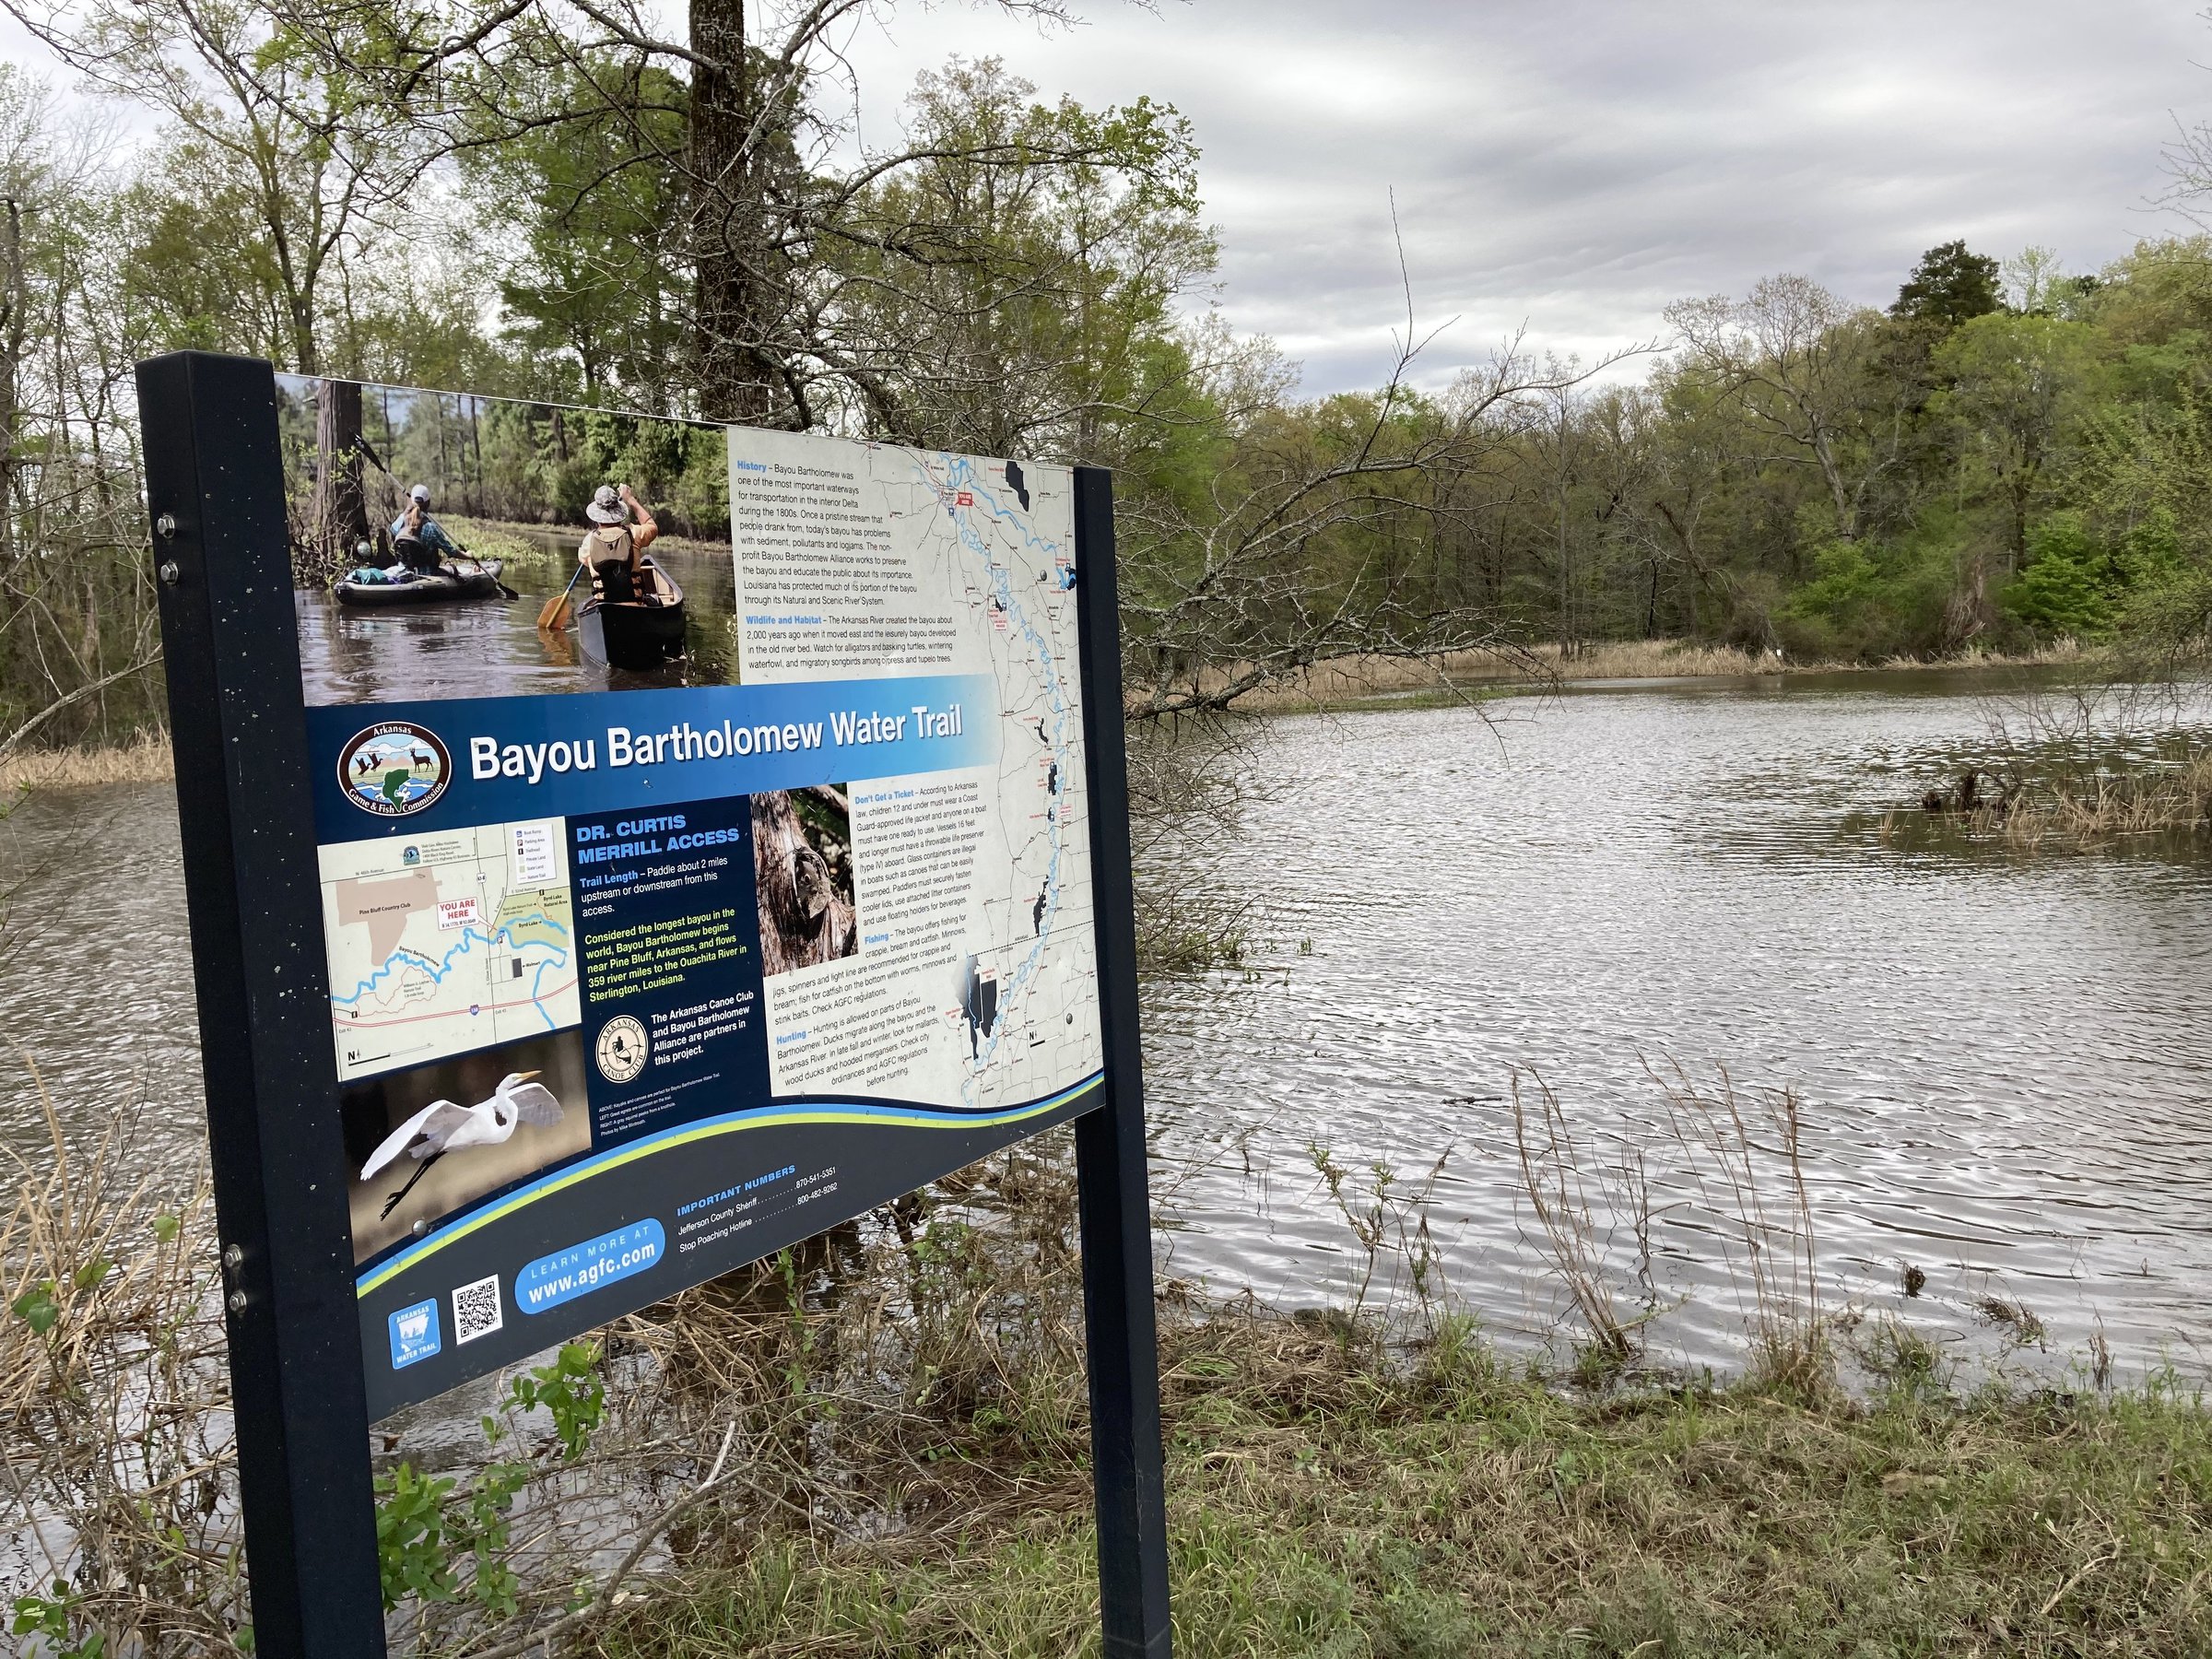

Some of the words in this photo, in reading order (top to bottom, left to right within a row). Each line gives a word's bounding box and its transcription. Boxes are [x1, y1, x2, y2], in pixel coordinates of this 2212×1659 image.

[737, 460, 766, 473] History
[774, 463, 796, 475] Bayou
[797, 466, 840, 478] Bartholomew
[738, 477, 751, 485] one
[752, 477, 760, 486] of
[761, 478, 773, 487] the
[793, 482, 824, 491] important
[826, 485, 859, 495] waterways
[738, 490, 748, 500] for
[749, 492, 798, 503] transportation
[807, 496, 818, 505] the
[819, 498, 841, 506] interior
[842, 498, 858, 508] Delta
[746, 615, 776, 624] Wildlife
[778, 615, 792, 624] and
[794, 615, 821, 624] Habitat
[828, 615, 840, 624] The
[841, 616, 868, 624] Arkansas
[869, 615, 884, 624] River
[918, 616, 936, 625] bayou
[373, 725, 412, 736] Arkansas
[470, 737, 596, 783] Bayou
[607, 722, 824, 766] Bartholomew
[829, 711, 907, 746] Water
[911, 704, 962, 738] Trail
[348, 788, 370, 808] Game
[370, 802, 377, 811] &
[379, 804, 394, 813] Fish
[402, 782, 444, 813] Commission
[855, 795, 873, 804] Don't
[874, 793, 887, 801] Get
[893, 789, 914, 799] Ticket
[919, 786, 947, 795] According
[954, 782, 978, 790] Arkansas
[577, 825, 611, 842] DR.
[616, 815, 686, 836] CURTIS
[578, 840, 662, 863] MERRILL
[666, 828, 739, 850] ACCESS
[579, 875, 602, 887] Trail
[604, 870, 638, 884] Length
[647, 865, 675, 877] Paddle
[677, 860, 699, 872] about
[701, 859, 706, 868] 2
[708, 857, 728, 867] miles
[581, 889, 621, 903] upstream
[622, 887, 631, 895] or
[633, 878, 683, 893] downstream
[684, 875, 702, 884] from
[703, 871, 718, 881] this
[440, 902, 458, 911] YOU
[459, 899, 475, 908] ARE
[448, 910, 469, 919] HERE
[582, 905, 615, 917] access.
[585, 926, 636, 944] Considered
[638, 924, 652, 934] the
[654, 917, 685, 931] longest
[687, 913, 711, 924] bayou
[713, 910, 720, 919] in
[722, 908, 735, 917] the
[864, 933, 889, 944] Fishing
[894, 928, 905, 937] The
[906, 925, 924, 934] bayou
[924, 920, 940, 930] offers
[941, 916, 958, 925] fishing
[585, 945, 614, 959] world,
[616, 941, 643, 953] Bayou
[645, 929, 701, 947] Bartholomew
[702, 923, 729, 935] begins
[587, 962, 608, 973] near
[609, 958, 629, 968] Pine
[631, 951, 654, 964] Bluff,
[656, 944, 697, 958] Arkansas,
[699, 938, 714, 949] and
[715, 935, 737, 946] flows
[588, 975, 605, 988] 359
[607, 972, 627, 983] river
[628, 967, 652, 979] miles
[653, 964, 662, 973] to
[664, 961, 678, 970] the
[680, 952, 716, 967] Ouachita
[718, 948, 738, 958] River
[739, 945, 747, 954] in
[589, 985, 641, 1002] Sterlington,
[642, 974, 685, 989] Louisiana.
[650, 1013, 667, 1024] The
[669, 1004, 707, 1019] Arkansas
[709, 997, 734, 1009] Canoe
[736, 990, 753, 1002] Club
[776, 1031, 806, 1044] Hunting
[813, 1021, 838, 1034] Hunting
[846, 1011, 869, 1024] allowed
[870, 1009, 878, 1017] on
[879, 1004, 894, 1015] parts
[895, 1000, 901, 1009] of
[902, 997, 920, 1007] Bayou
[603, 1019, 639, 1041] ARKANSAS
[652, 1025, 668, 1038] and
[670, 1020, 696, 1033] Bayou
[697, 1006, 750, 1026] Bartholomew
[653, 1037, 686, 1052] Alliance
[688, 1032, 702, 1042] are
[703, 1023, 737, 1040] partners
[738, 1019, 746, 1028] in
[348, 1051, 356, 1061] N
[603, 1063, 625, 1079] CANOE
[628, 1054, 644, 1075] CLUB
[654, 1054, 671, 1065] this
[672, 1045, 704, 1062] project.
[677, 1185, 741, 1216] IMPORTANT
[744, 1165, 795, 1190] NUMBERS
[678, 1218, 709, 1235] Jefferson
[710, 1208, 734, 1222] County
[735, 1197, 758, 1213] Sheriff
[796, 1166, 836, 1189] 870-541-5351
[679, 1241, 696, 1252] Stop
[697, 1228, 728, 1245] Poaching
[729, 1219, 752, 1232] Hotline
[797, 1182, 837, 1205] 800-482-9262
[531, 1253, 580, 1279] LEARN
[588, 1237, 626, 1257] MORE
[634, 1226, 649, 1239] AT
[528, 1242, 655, 1304] www.agfc.com
[396, 1305, 429, 1324] ARKANSAS
[396, 1348, 416, 1364] WATER
[418, 1343, 437, 1358] TRAIL
